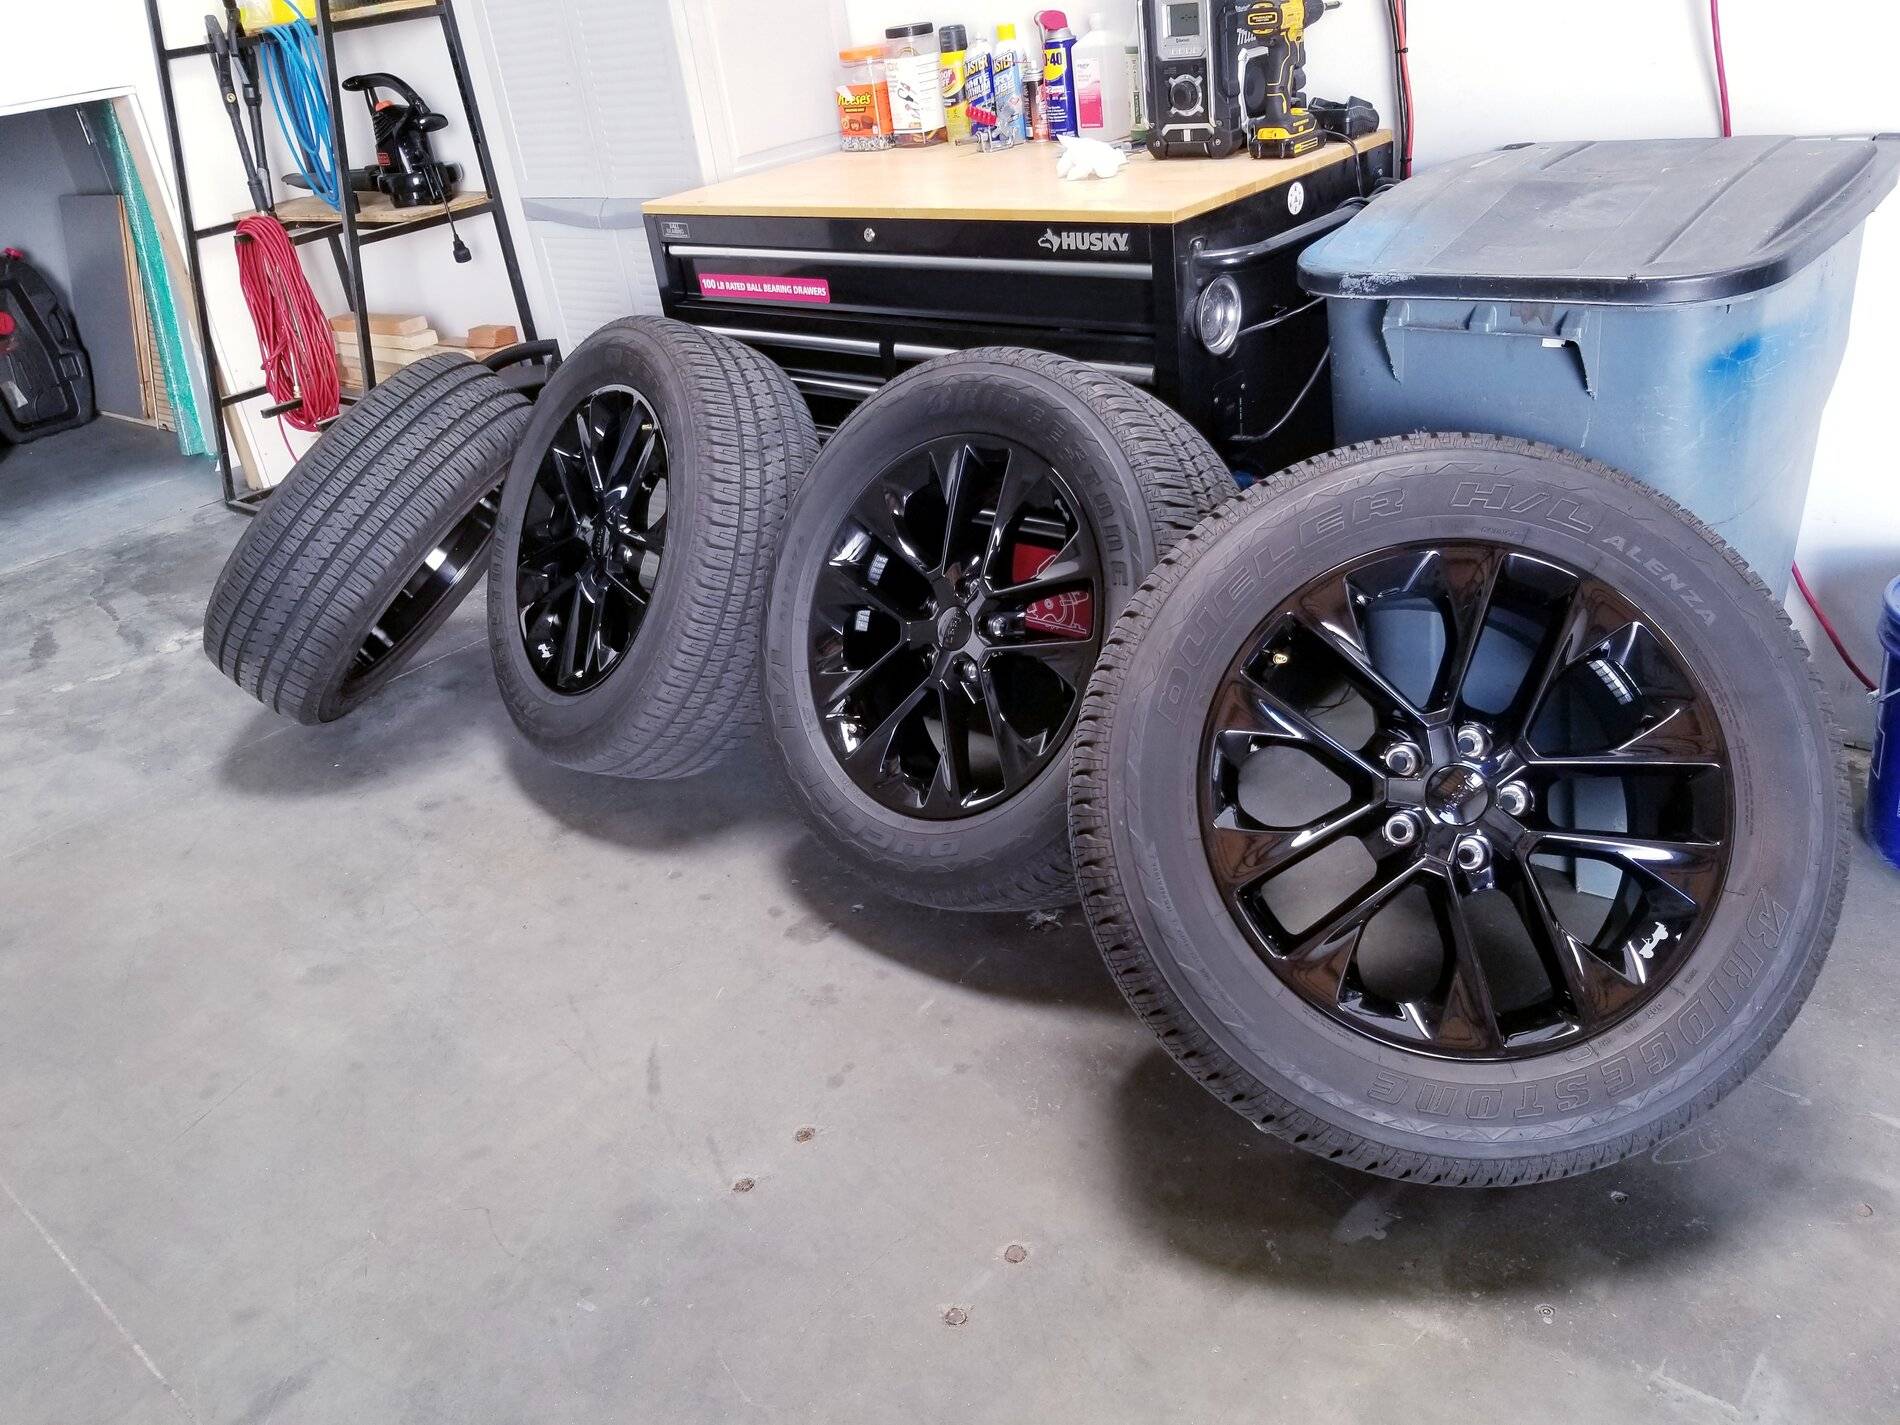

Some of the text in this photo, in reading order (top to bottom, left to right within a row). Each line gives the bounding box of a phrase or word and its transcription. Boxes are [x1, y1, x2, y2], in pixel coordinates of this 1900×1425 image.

[702, 279, 826, 297] 100 LB RATED BALL BEARING DRAWERS
[1061, 232, 1128, 251] HUSKY
[1157, 481, 1717, 725] DUELER H/L ALENZA
[1367, 890, 1789, 1121] BRIDGESTONE
